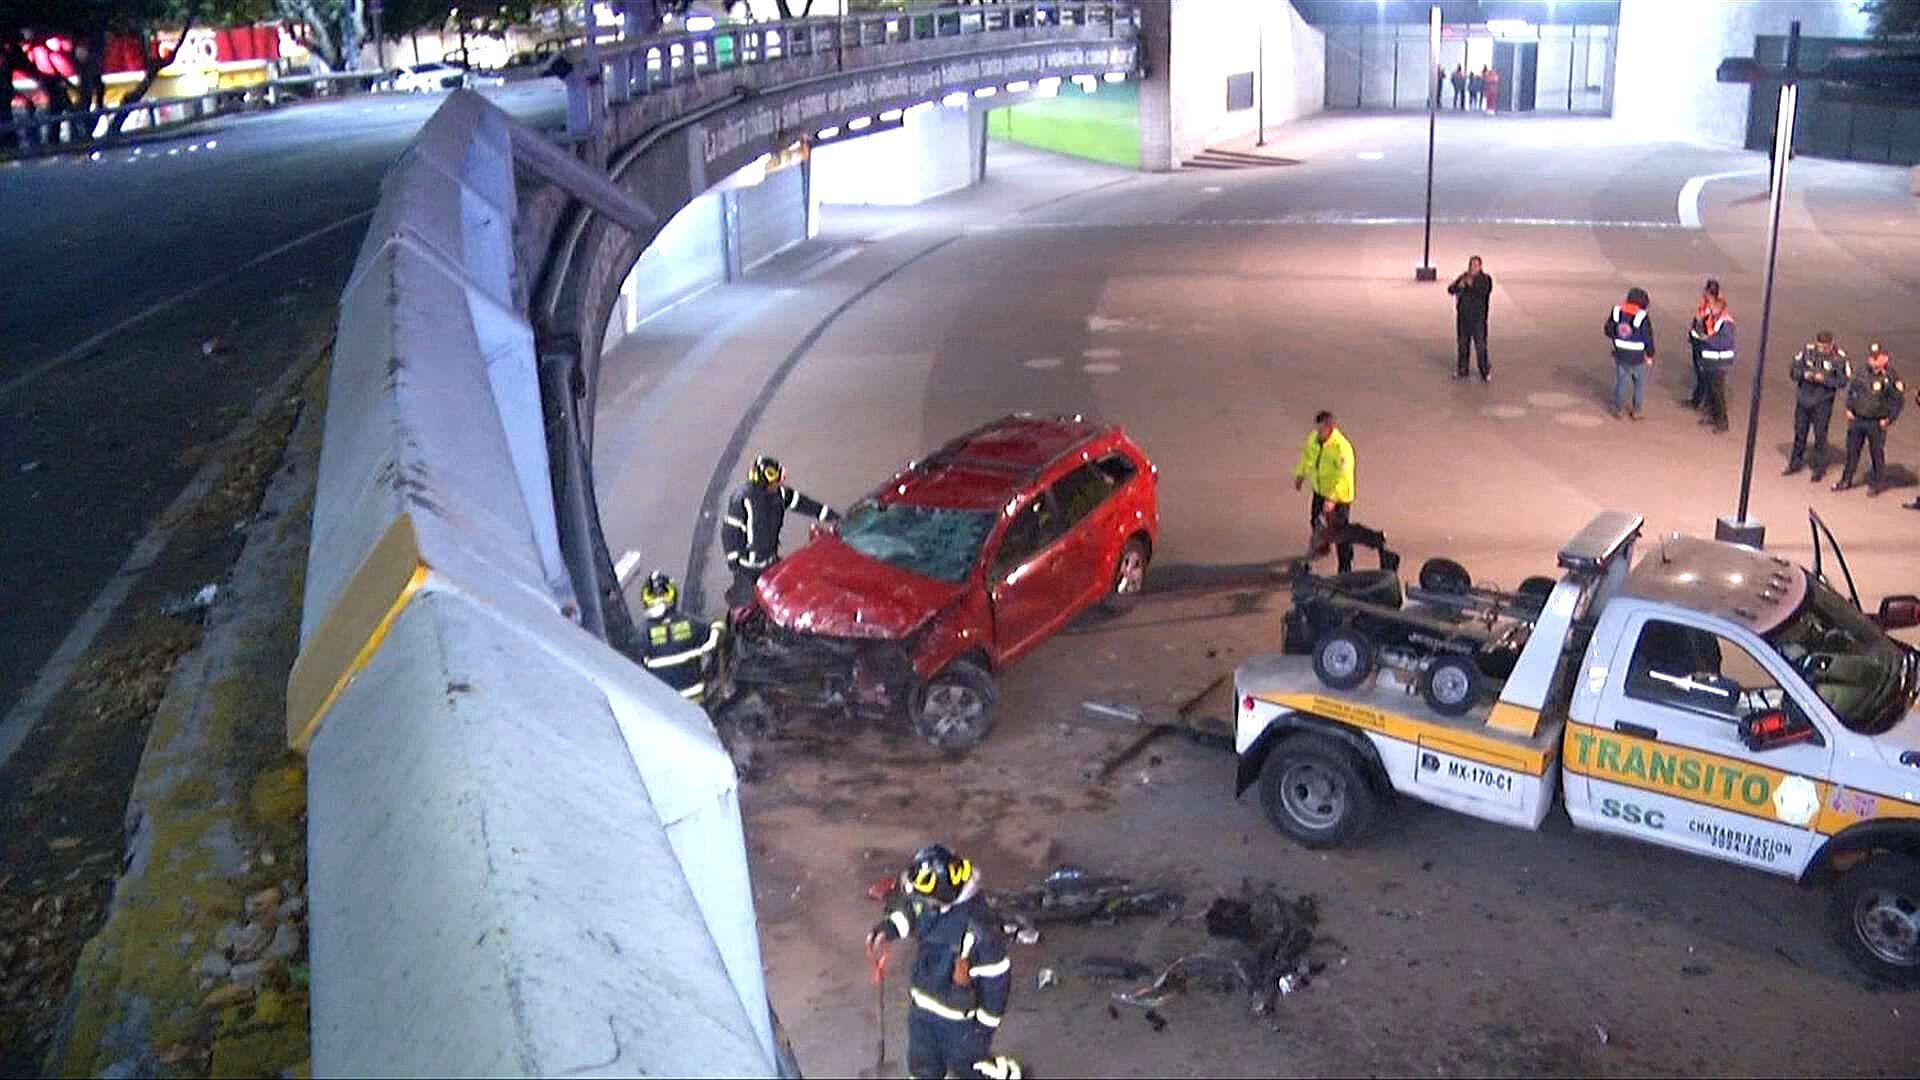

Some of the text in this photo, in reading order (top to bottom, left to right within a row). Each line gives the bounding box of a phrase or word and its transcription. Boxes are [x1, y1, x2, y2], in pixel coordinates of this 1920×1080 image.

[1448, 761, 1512, 792] MX-170-C1
[1575, 732, 1769, 806] TRANSITO
[1601, 799, 1664, 829] SSC
